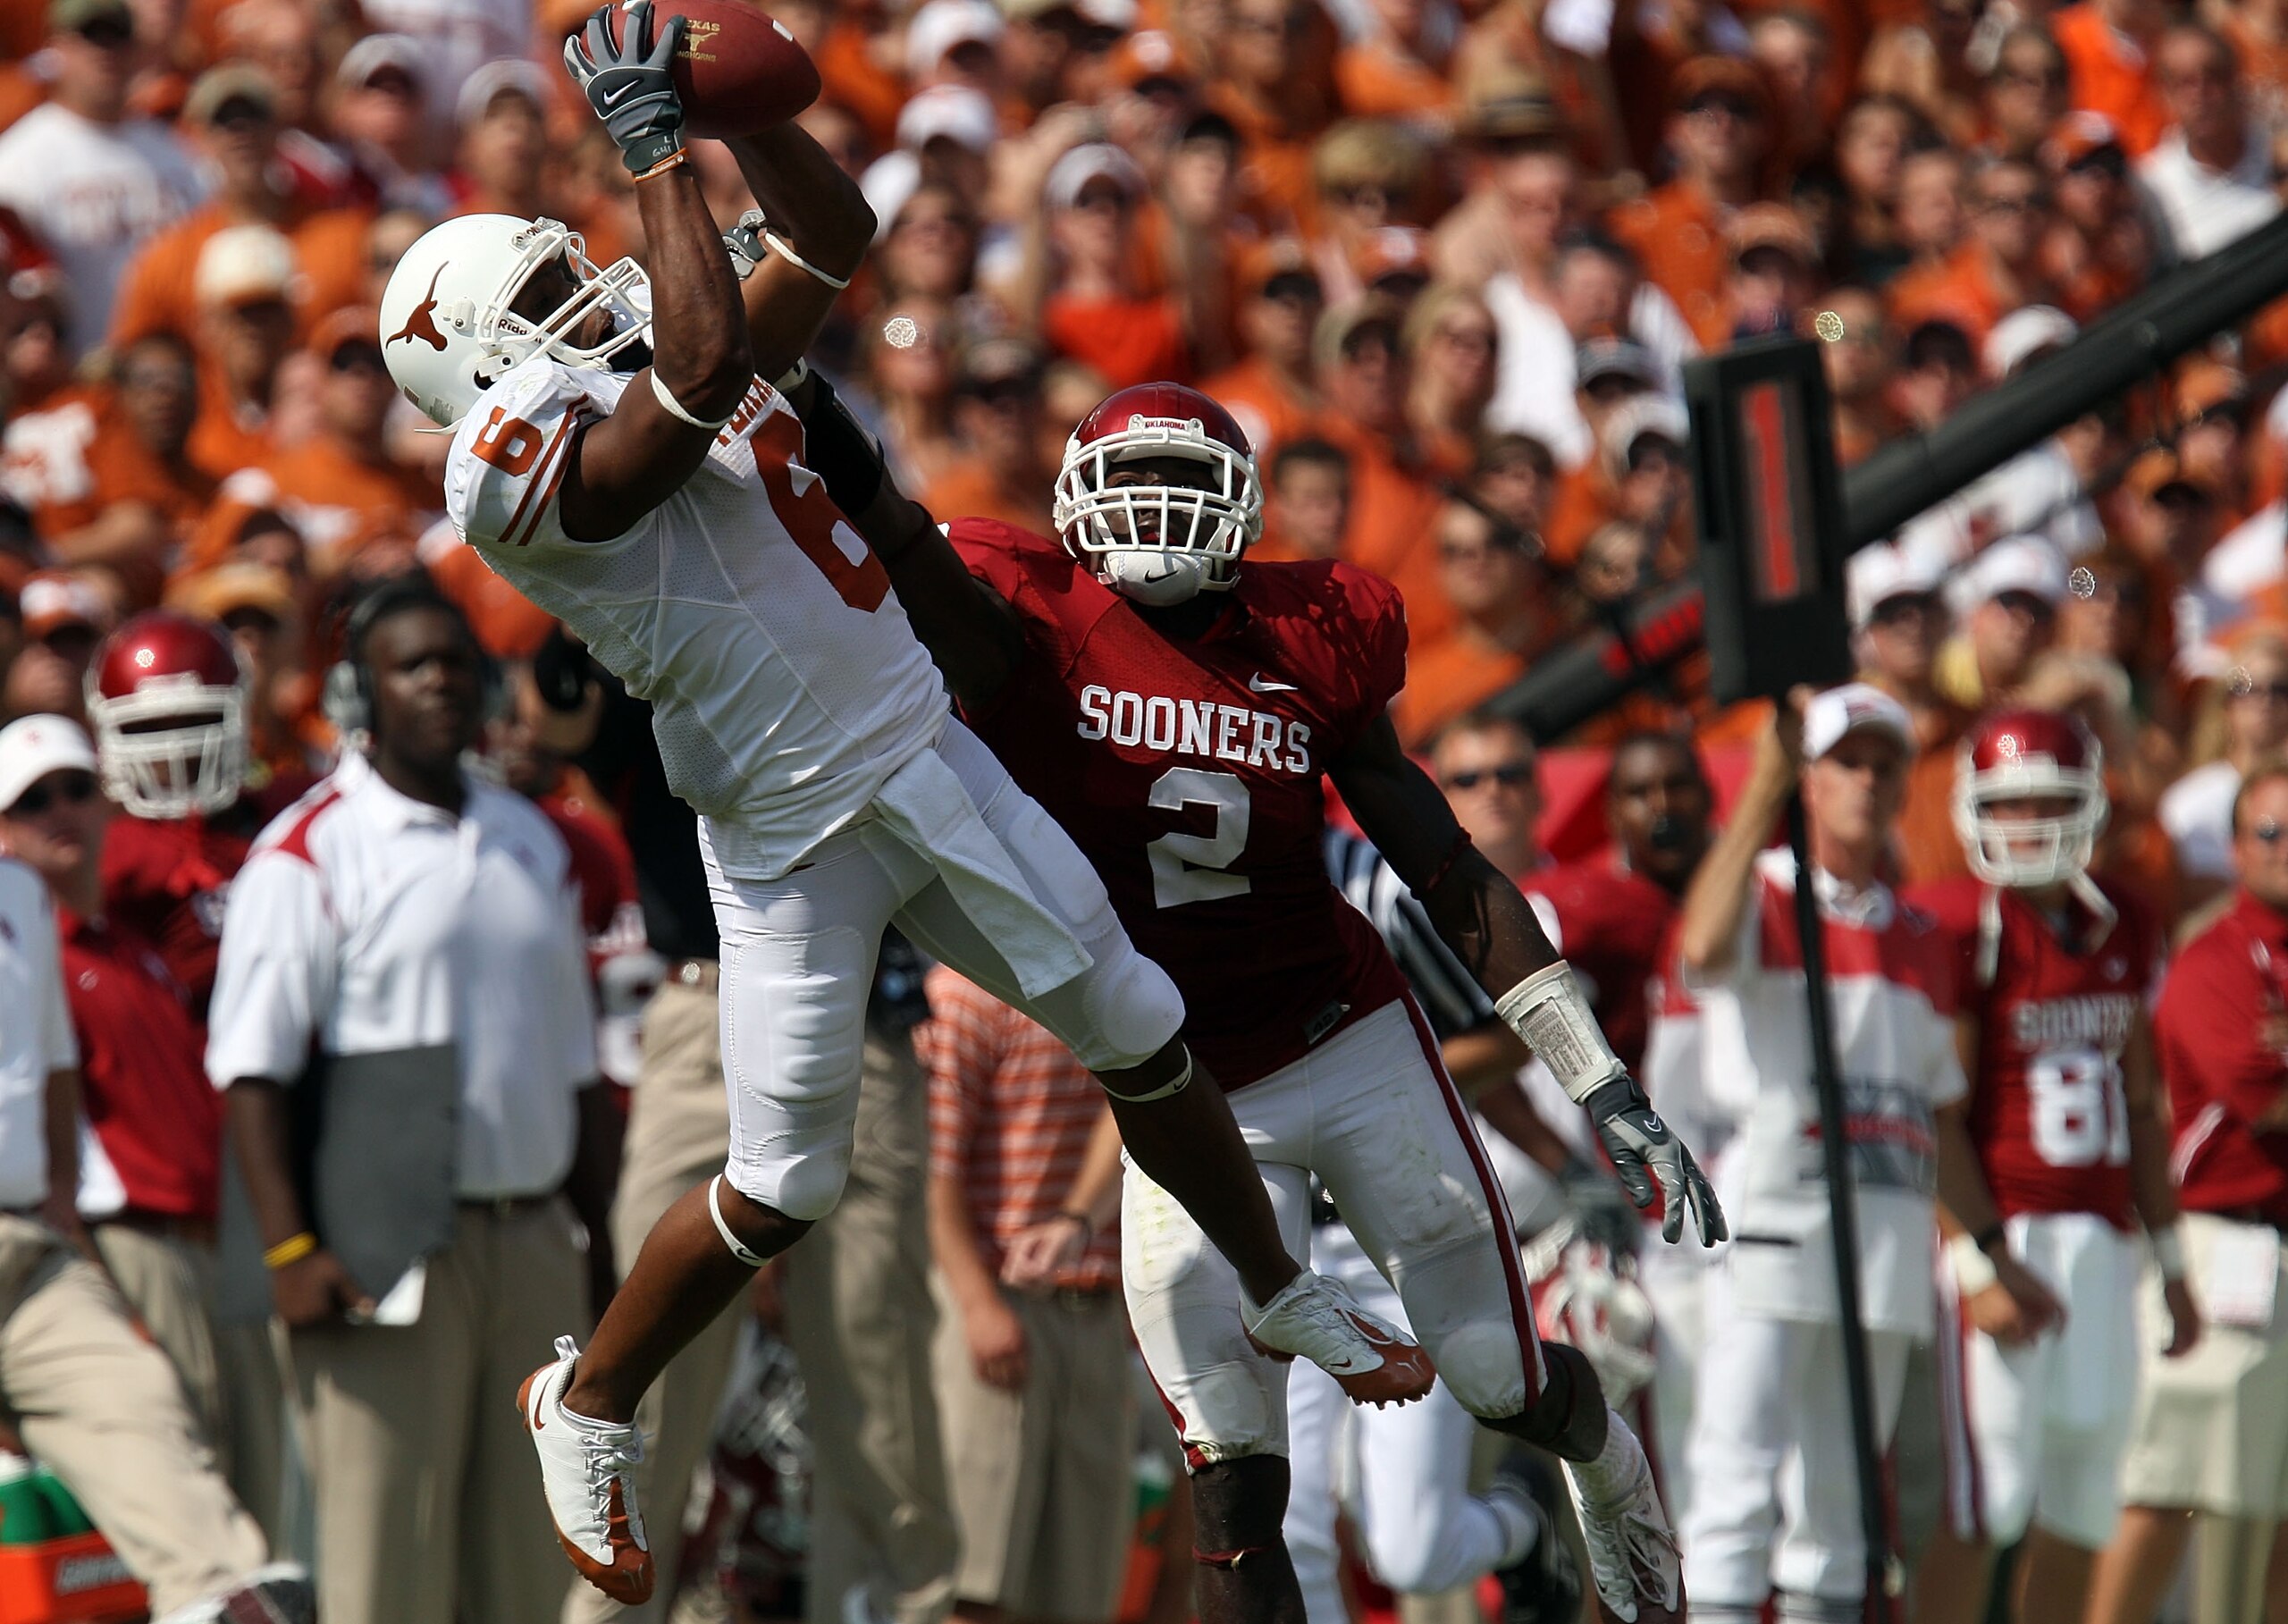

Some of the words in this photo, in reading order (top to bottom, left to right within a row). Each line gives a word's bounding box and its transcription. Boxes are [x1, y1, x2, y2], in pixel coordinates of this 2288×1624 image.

[686, 19, 720, 32] EXAS
[470, 405, 543, 477] 6
[1145, 419, 1186, 431] OKLAHOMA
[749, 408, 891, 614] 6
[1077, 684, 1311, 774] SOONERS
[1147, 766, 1251, 910] 2
[2026, 1049, 2132, 1168] 81
